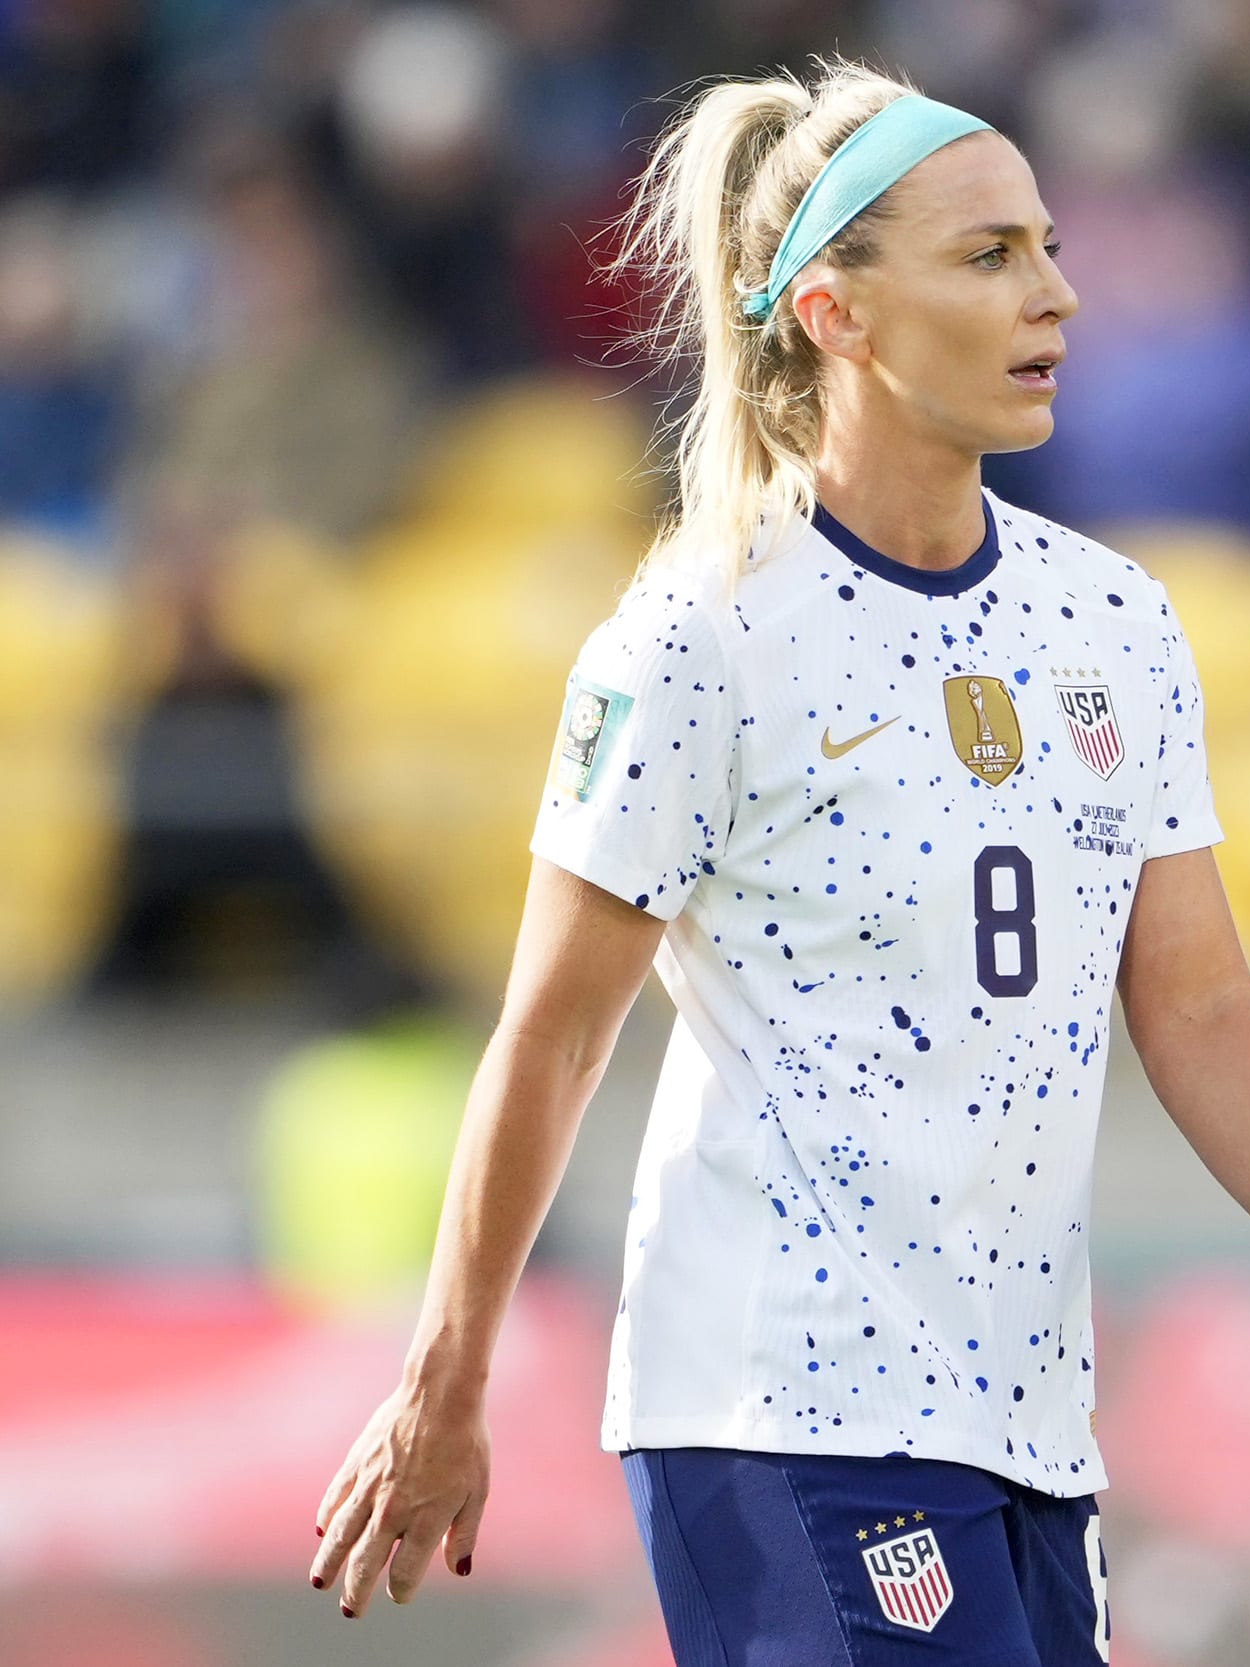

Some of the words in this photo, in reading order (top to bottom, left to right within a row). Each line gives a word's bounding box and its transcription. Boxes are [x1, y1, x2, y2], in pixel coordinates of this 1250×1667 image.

[1059, 691, 1108, 727] USA
[971, 744, 1007, 759] FIFA
[982, 764, 1003, 773] 2019
[974, 845, 1038, 998] 8
[869, 1534, 935, 1578] USA
